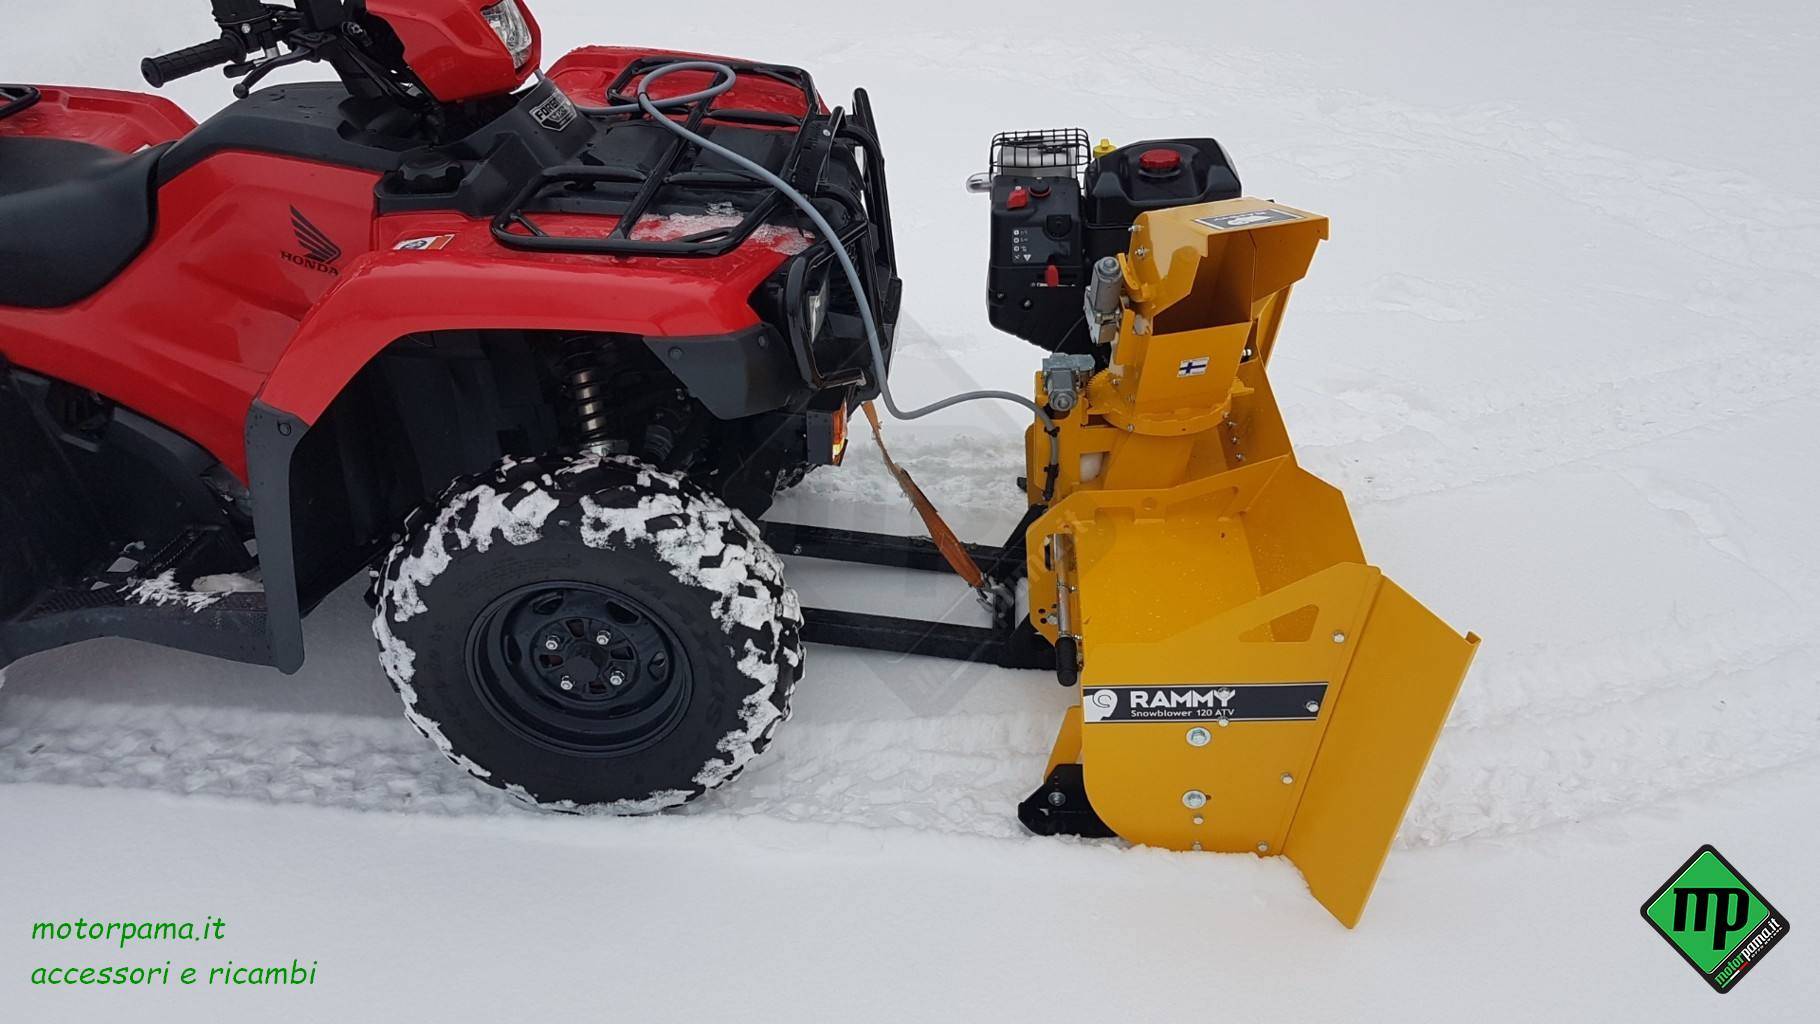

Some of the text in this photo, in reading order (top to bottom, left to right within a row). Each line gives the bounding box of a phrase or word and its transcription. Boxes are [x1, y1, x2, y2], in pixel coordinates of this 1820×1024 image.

[535, 92, 568, 121] FORE
[280, 251, 339, 276] HONDA
[1130, 690, 1236, 708] RAMMY
[1196, 709, 1213, 717] 120
[1215, 709, 1235, 717] ATV
